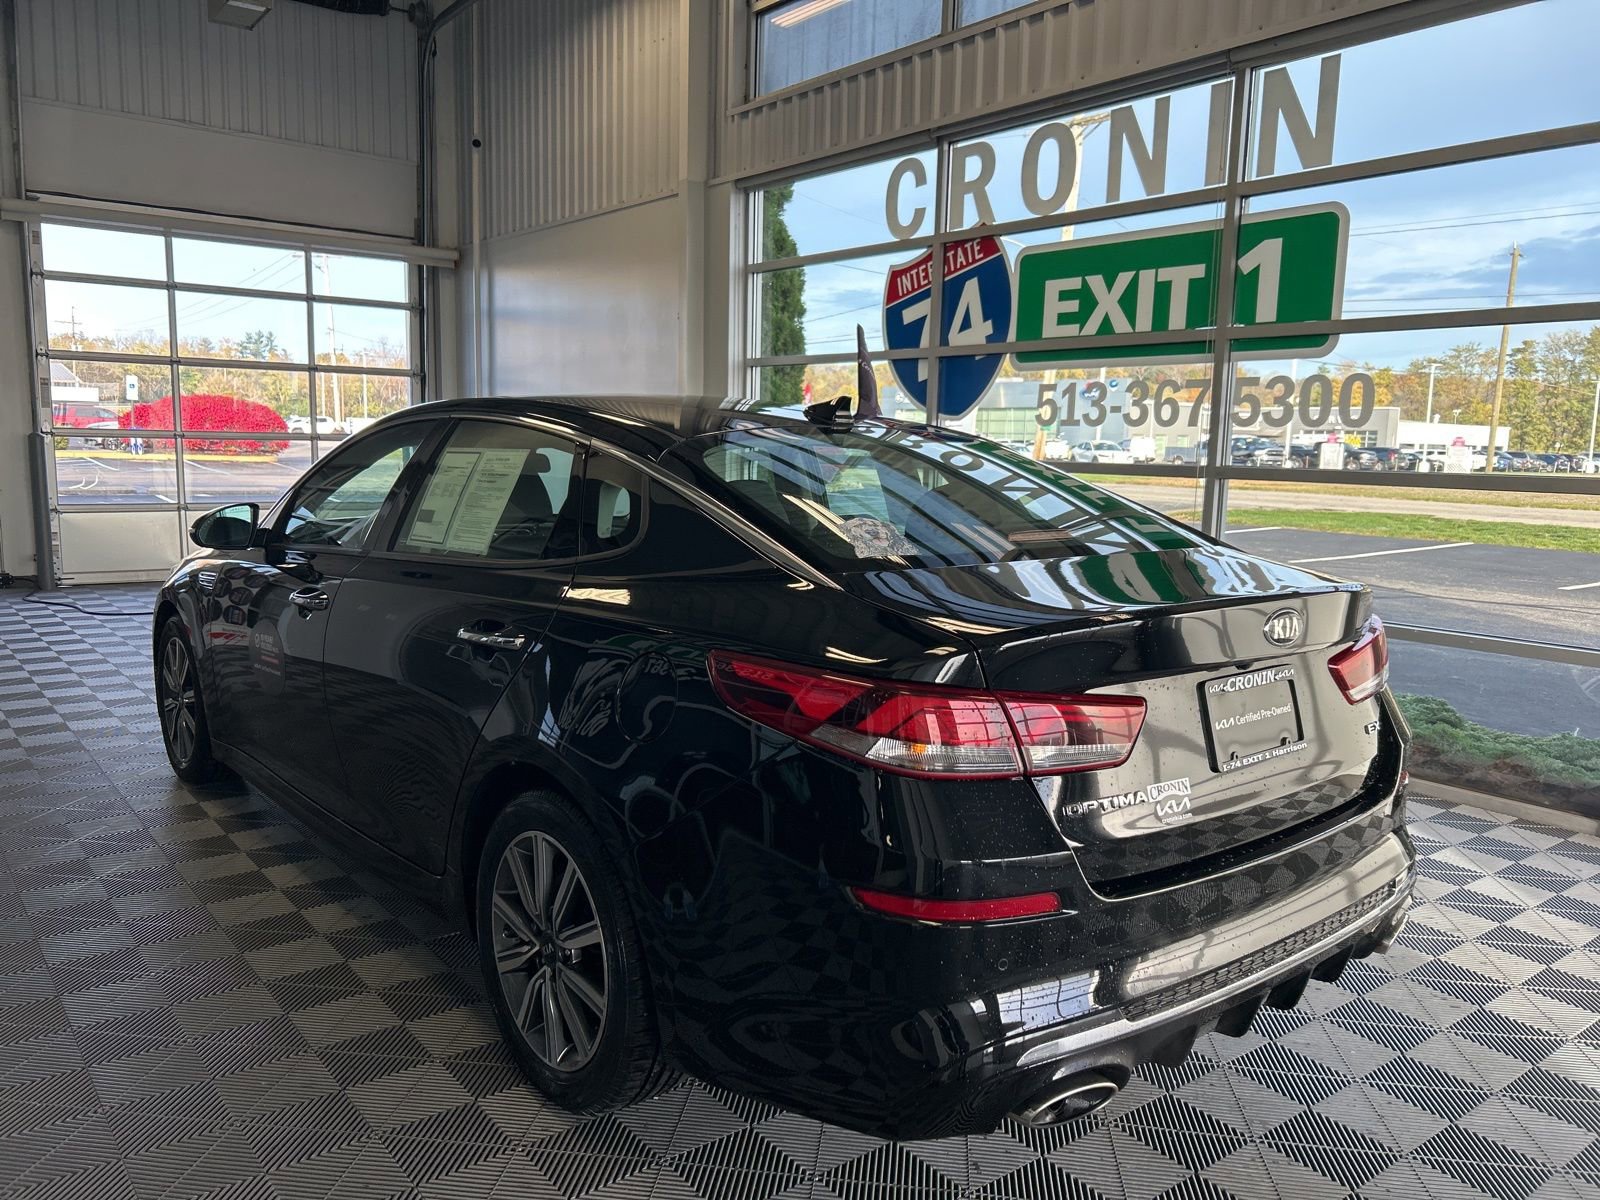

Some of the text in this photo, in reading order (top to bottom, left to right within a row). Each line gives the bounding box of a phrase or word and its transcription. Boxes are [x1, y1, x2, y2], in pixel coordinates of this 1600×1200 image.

[886, 53, 1342, 240] CRONIN
[896, 238, 984, 297] INTERTATE
[1042, 236, 1284, 339] EXIT 1
[902, 276, 994, 383] 74
[1035, 372, 1376, 429] 513-3675300
[1273, 616, 1299, 640] KIA
[1226, 669, 1275, 692] CRONIN
[1215, 703, 1292, 730] KIA Certified Pre-Owned
[1368, 720, 1381, 734] EX
[1222, 760, 1241, 772] I-74
[1243, 753, 1263, 766] EXIT
[1272, 742, 1308, 757] Harrison
[1149, 779, 1190, 800] CRONIN
[1062, 791, 1149, 817] OPTIMA
[1156, 796, 1192, 817] KIA
[1161, 811, 1193, 825] croninkia.com
